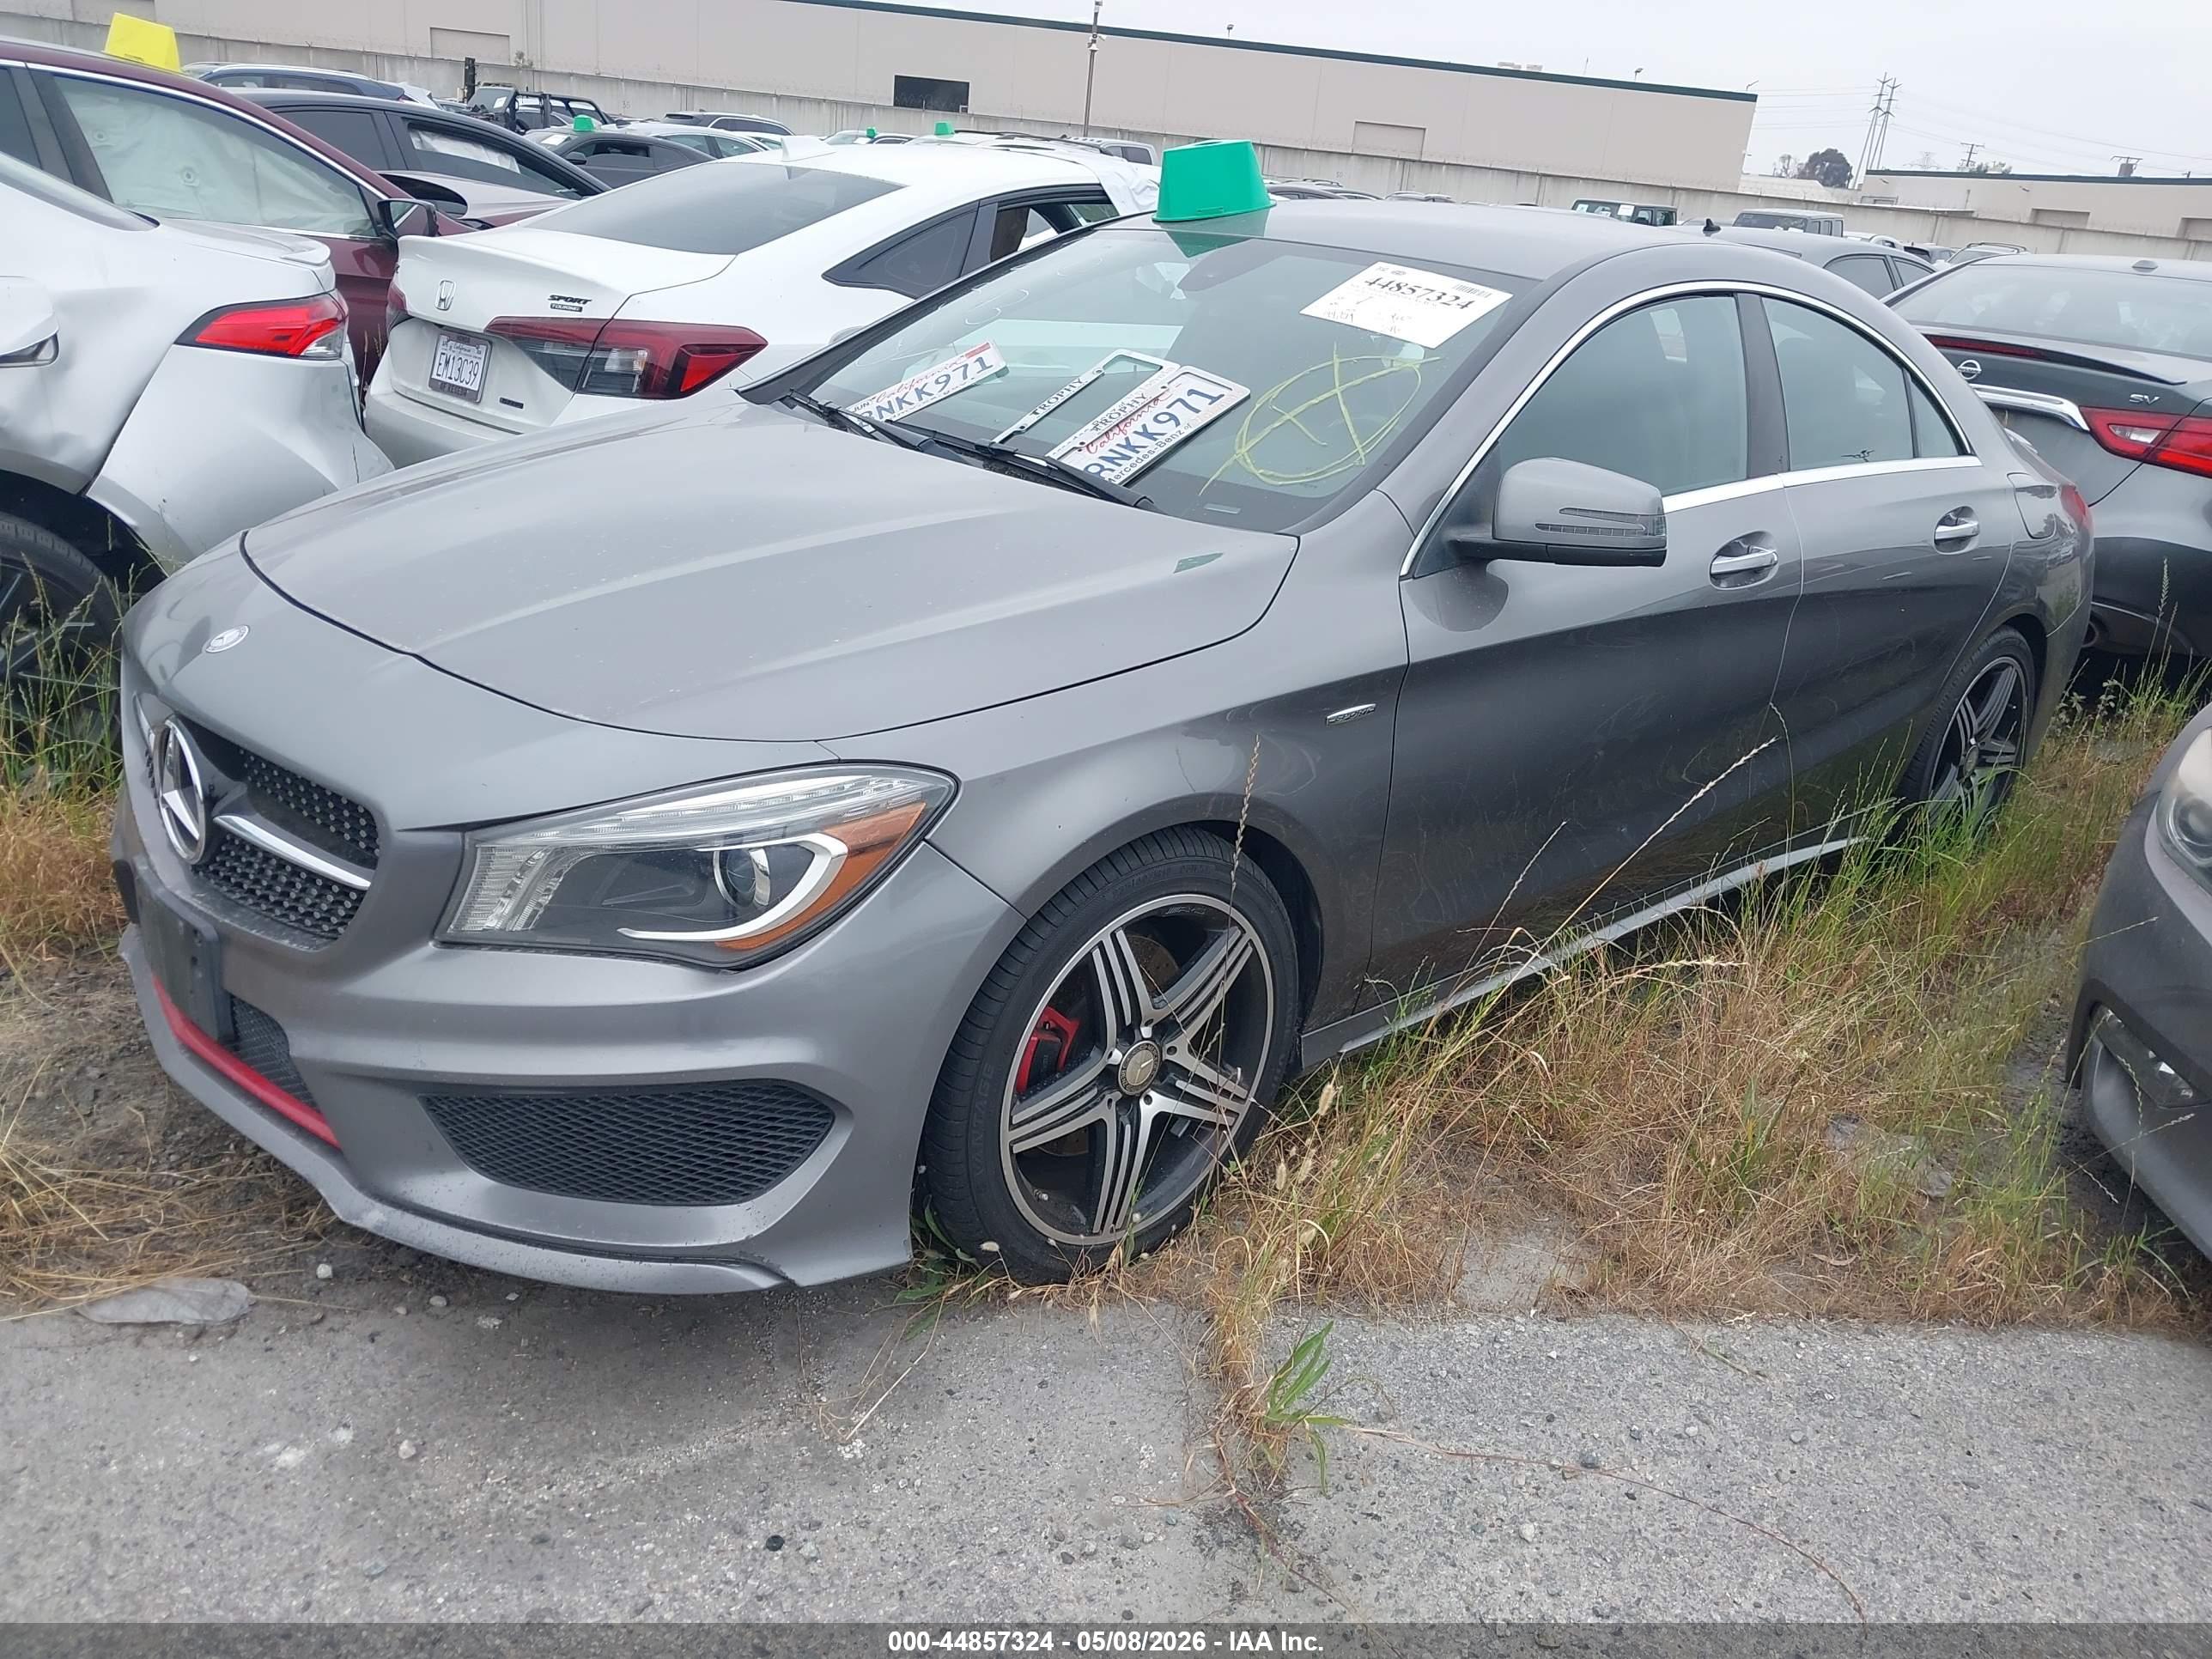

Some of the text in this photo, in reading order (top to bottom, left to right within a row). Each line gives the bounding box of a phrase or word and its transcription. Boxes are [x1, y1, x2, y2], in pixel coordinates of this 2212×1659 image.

[548, 295, 592, 305] SPORT
[1364, 276, 1476, 310] 44857324
[436, 352, 480, 386] EM13C39
[1031, 378, 1086, 416] TROPHY
[1091, 392, 1148, 432] TROPHY
[2129, 393, 2160, 406] SV
[1086, 392, 1174, 454] California
